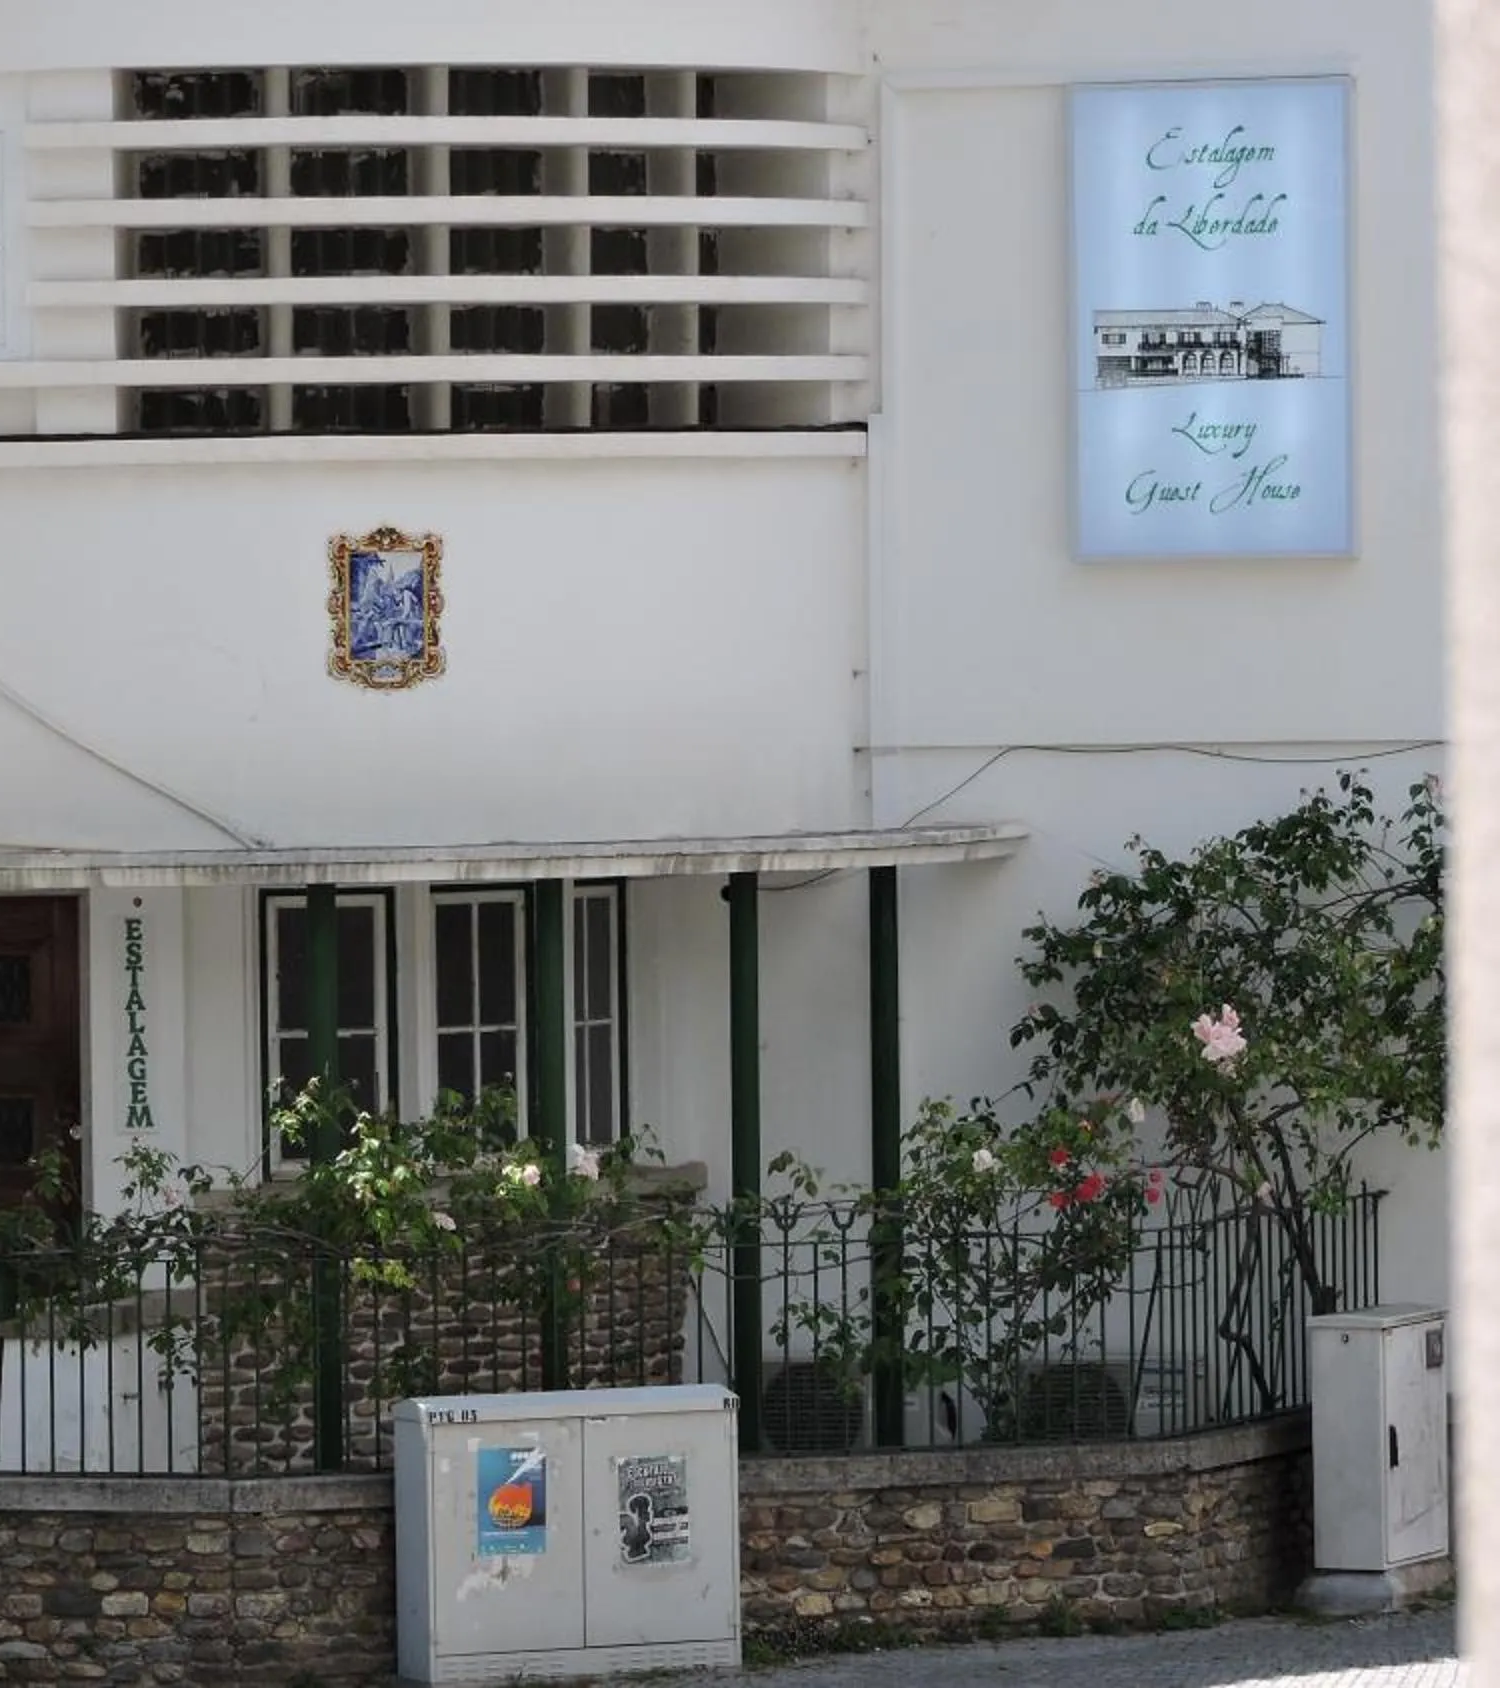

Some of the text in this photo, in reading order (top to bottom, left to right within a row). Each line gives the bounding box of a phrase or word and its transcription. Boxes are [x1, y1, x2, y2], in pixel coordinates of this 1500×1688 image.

[1146, 125, 1275, 188] Estalagem
[1133, 193, 1287, 250] da Liberdade
[1172, 411, 1257, 459] Luxury
[1125, 454, 1301, 516] Guest House
[125, 918, 154, 1128] ESTALAGEM
